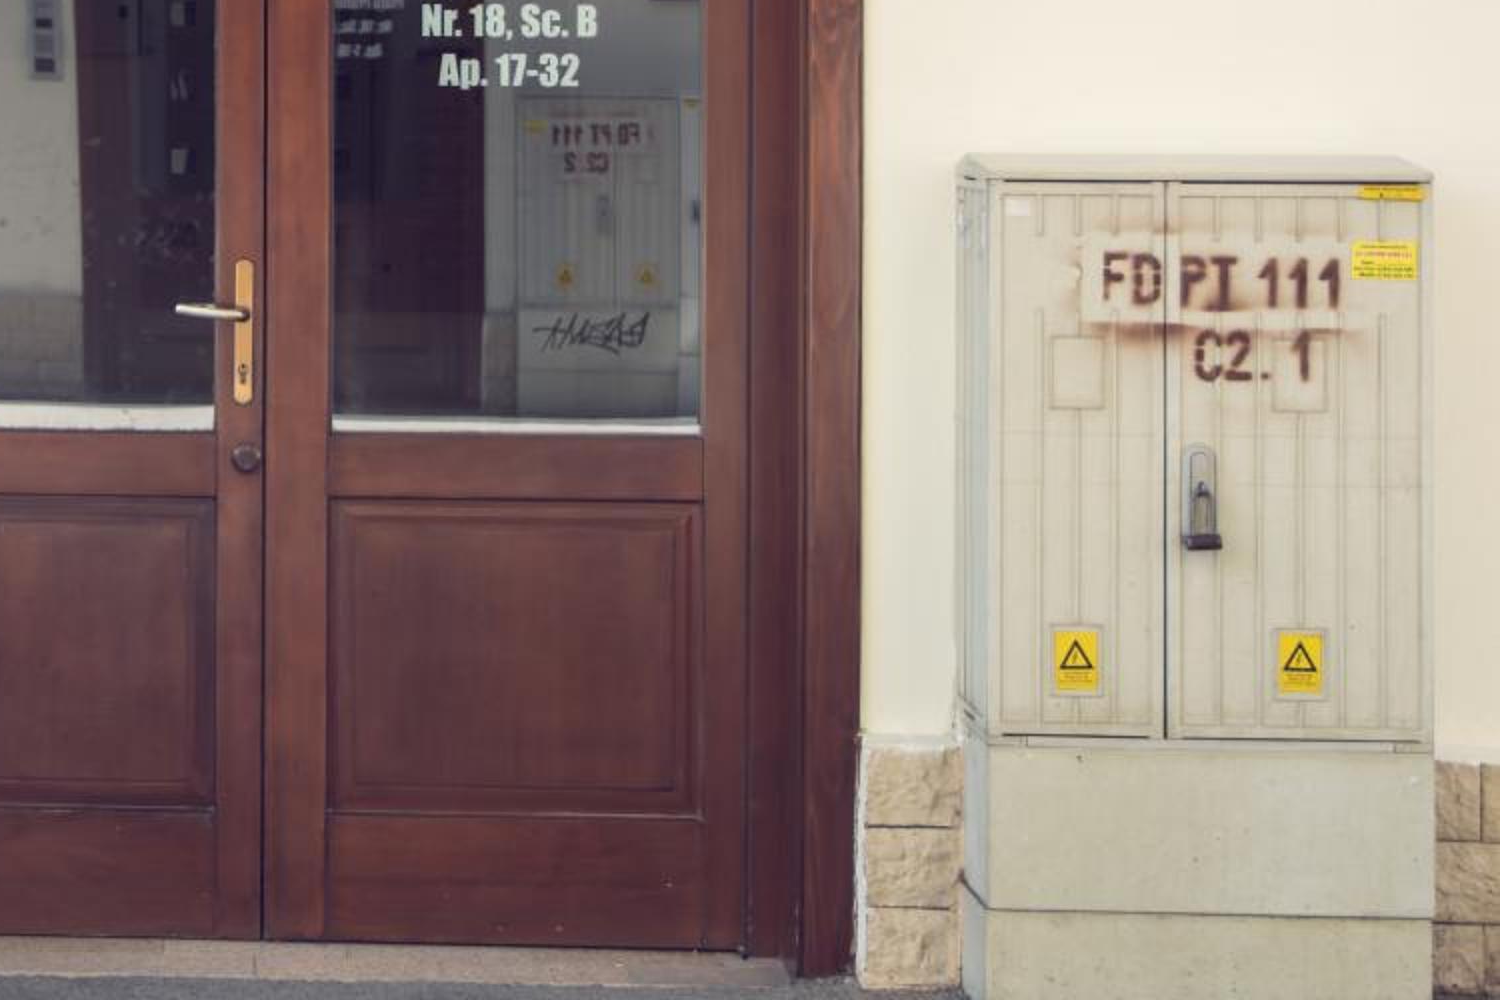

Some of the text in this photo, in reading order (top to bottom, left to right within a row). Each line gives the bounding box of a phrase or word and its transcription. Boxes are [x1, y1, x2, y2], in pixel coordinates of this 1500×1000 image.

[421, 3, 462, 37] Nr.
[469, 3, 513, 40] 18,
[520, 3, 570, 38] Sc.
[576, 4, 598, 37] B
[438, 53, 580, 90] Ap. 17-32
[1102, 252, 1162, 304] FD
[1257, 257, 1340, 309] 111
